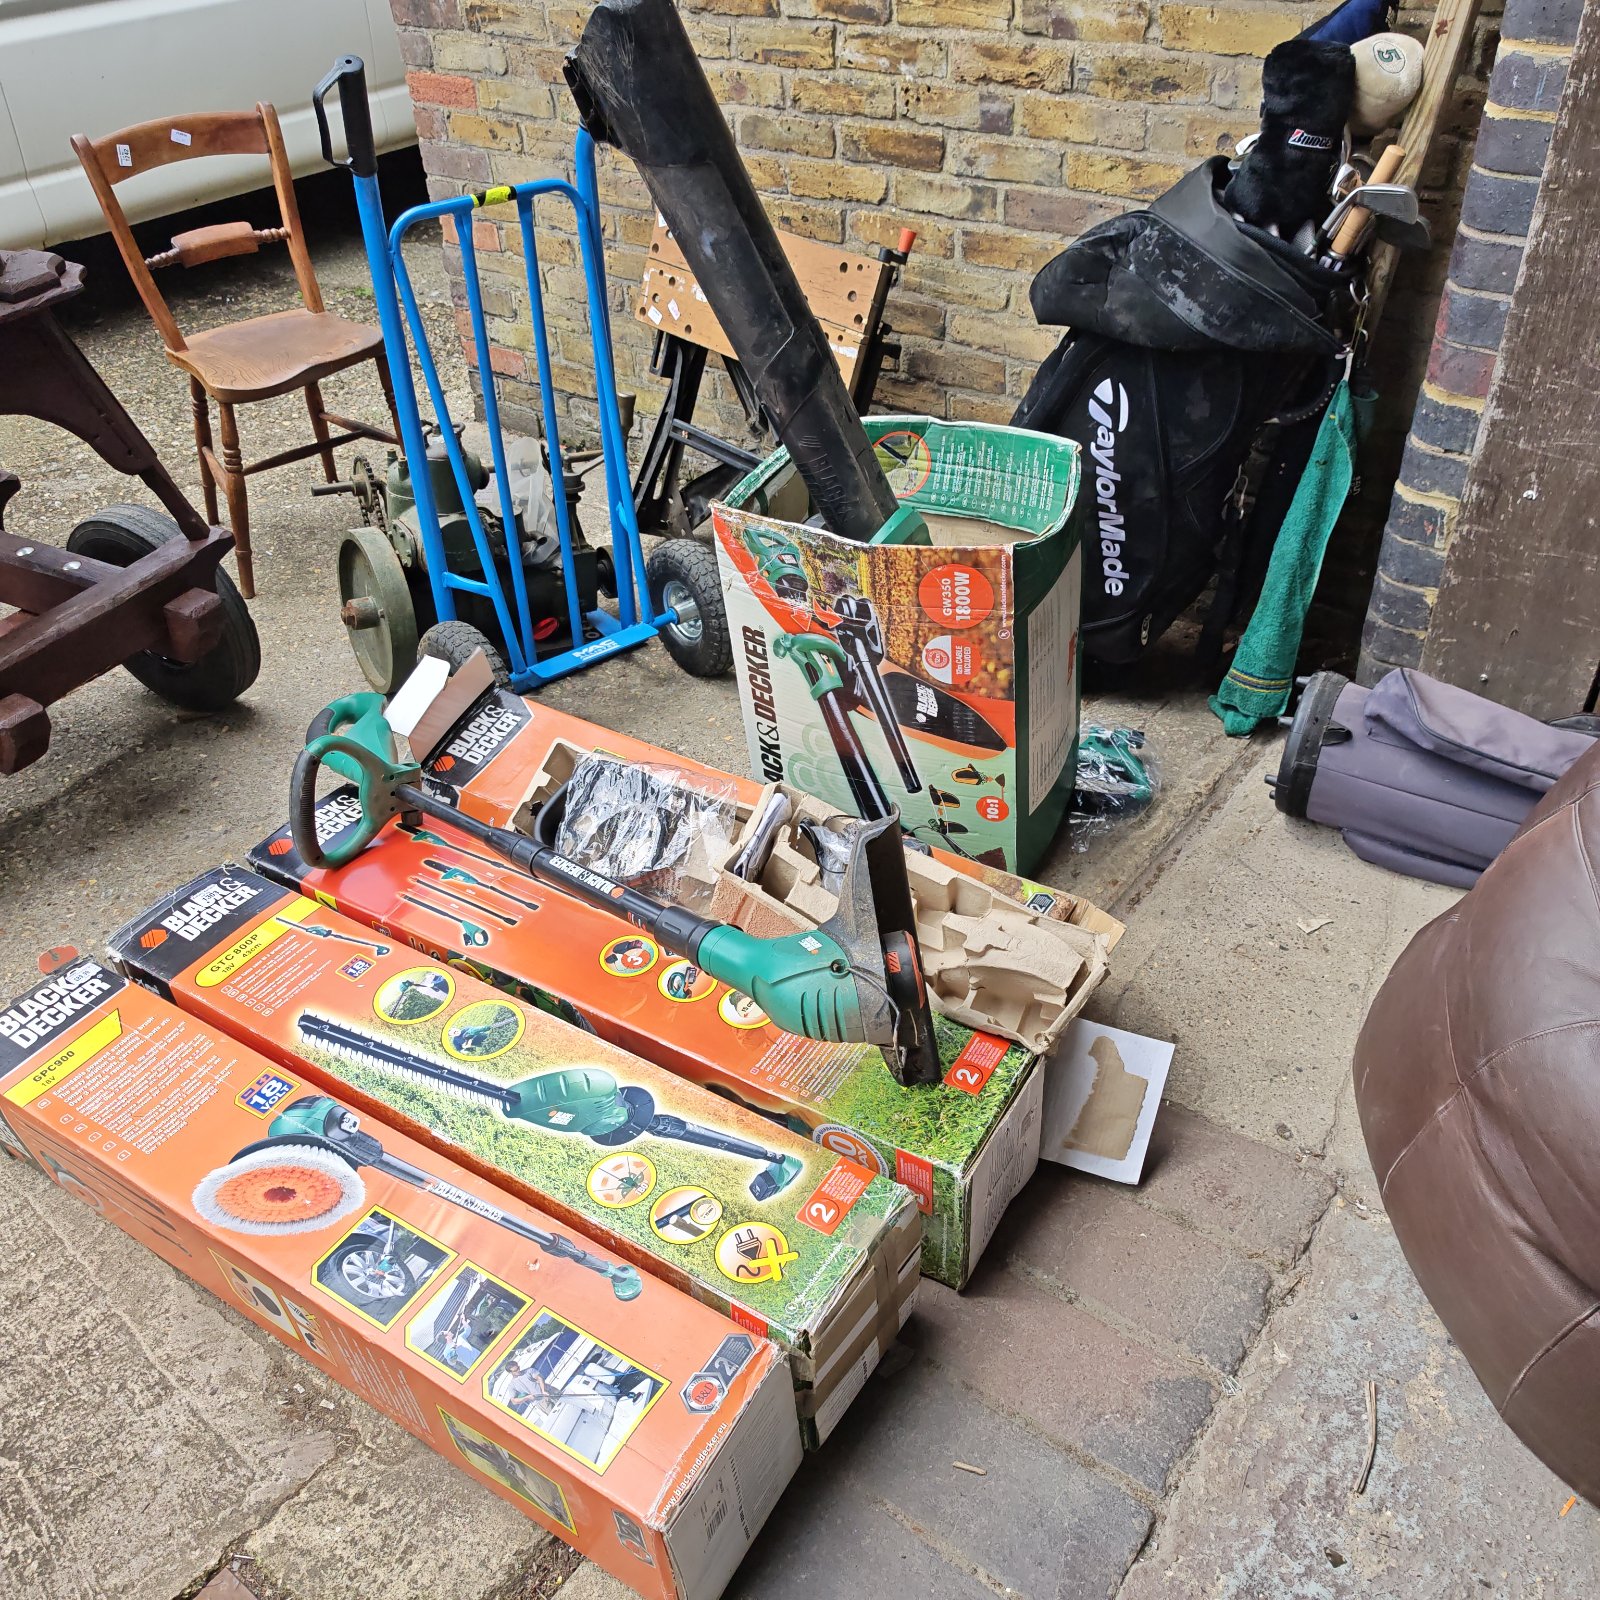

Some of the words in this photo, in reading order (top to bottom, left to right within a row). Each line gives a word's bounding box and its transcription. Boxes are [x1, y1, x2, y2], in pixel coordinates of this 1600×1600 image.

[1377, 48, 1402, 63] 5
[1089, 378, 1130, 597] TaylorMade
[942, 577, 952, 617] GW350
[954, 572, 971, 622] 1800W
[742, 625, 778, 724] DECKER
[466, 711, 522, 764] DECKER
[759, 736, 784, 785] ACK
[986, 798, 999, 819] 10:1
[176, 885, 259, 941] DECKER
[210, 953, 234, 973] GTC
[233, 934, 258, 956] 800P
[346, 960, 365, 976] 18
[627, 956, 643, 966] 3
[352, 964, 371, 978] VOLT
[9, 978, 112, 1049] DECKER
[32, 1050, 76, 1083] GPC900
[41, 1075, 56, 1088] 18V
[956, 1069, 979, 1085] 2
[250, 1077, 283, 1110] 18
[260, 1084, 290, 1111] VOLT
[811, 1203, 835, 1223] 2
[695, 1382, 713, 1404] B&D
[659, 1422, 728, 1518] www.blackanddecker.eu
